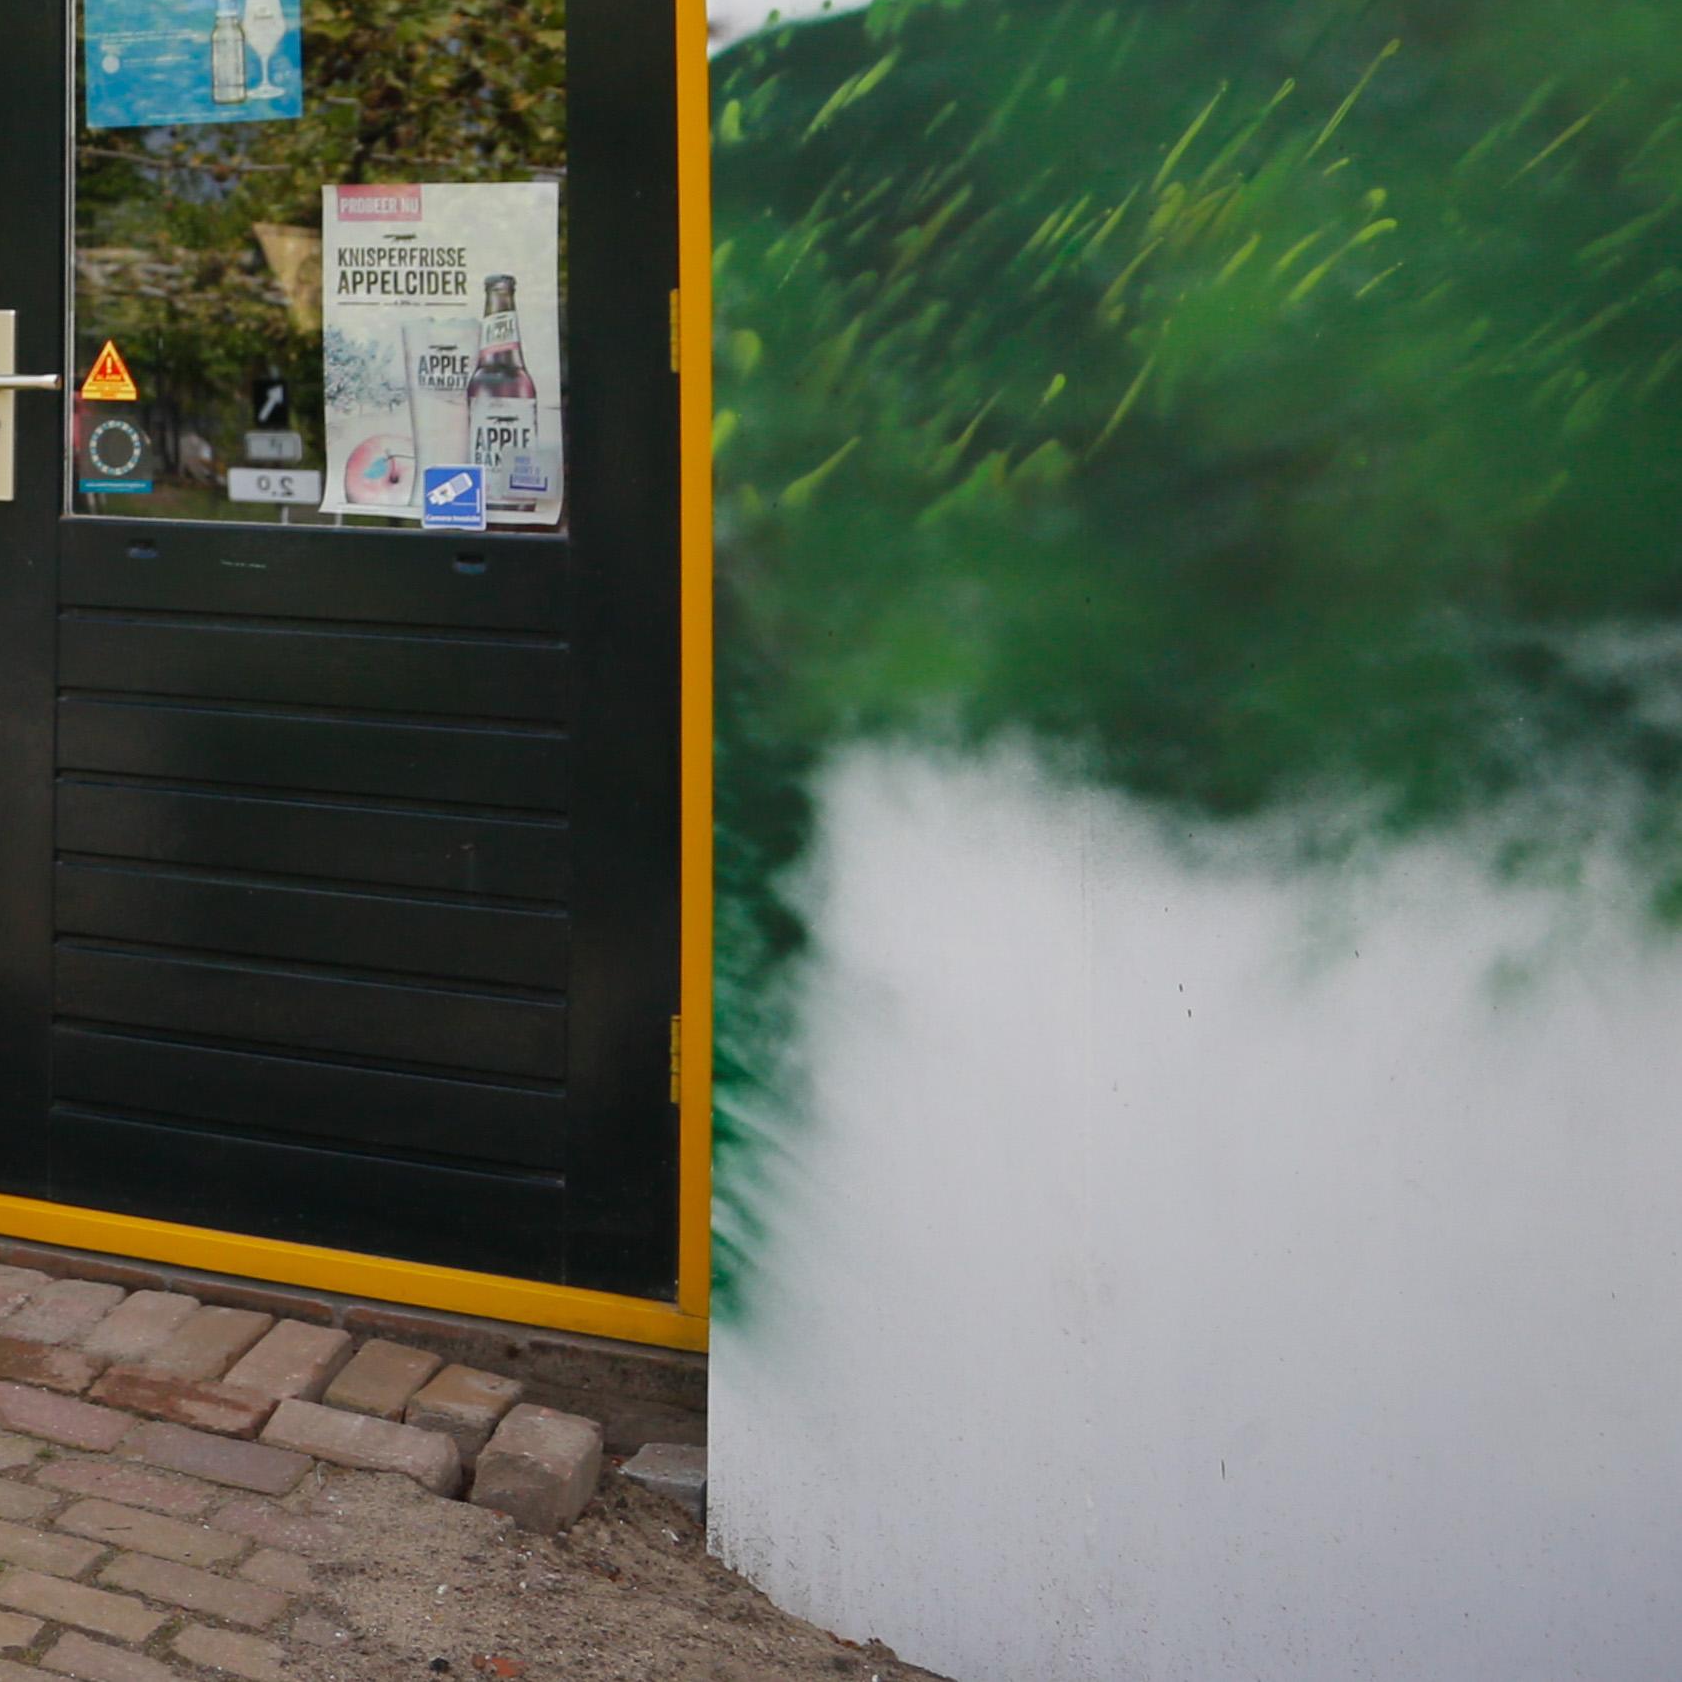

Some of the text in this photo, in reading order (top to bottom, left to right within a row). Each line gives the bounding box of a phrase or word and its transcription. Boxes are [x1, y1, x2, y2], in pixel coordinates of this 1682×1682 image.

[339, 197, 419, 214] PROBEER NU
[337, 247, 467, 267] KNISPERFRISSE
[337, 270, 468, 296] APPELCIDER
[418, 355, 470, 375] APPLE
